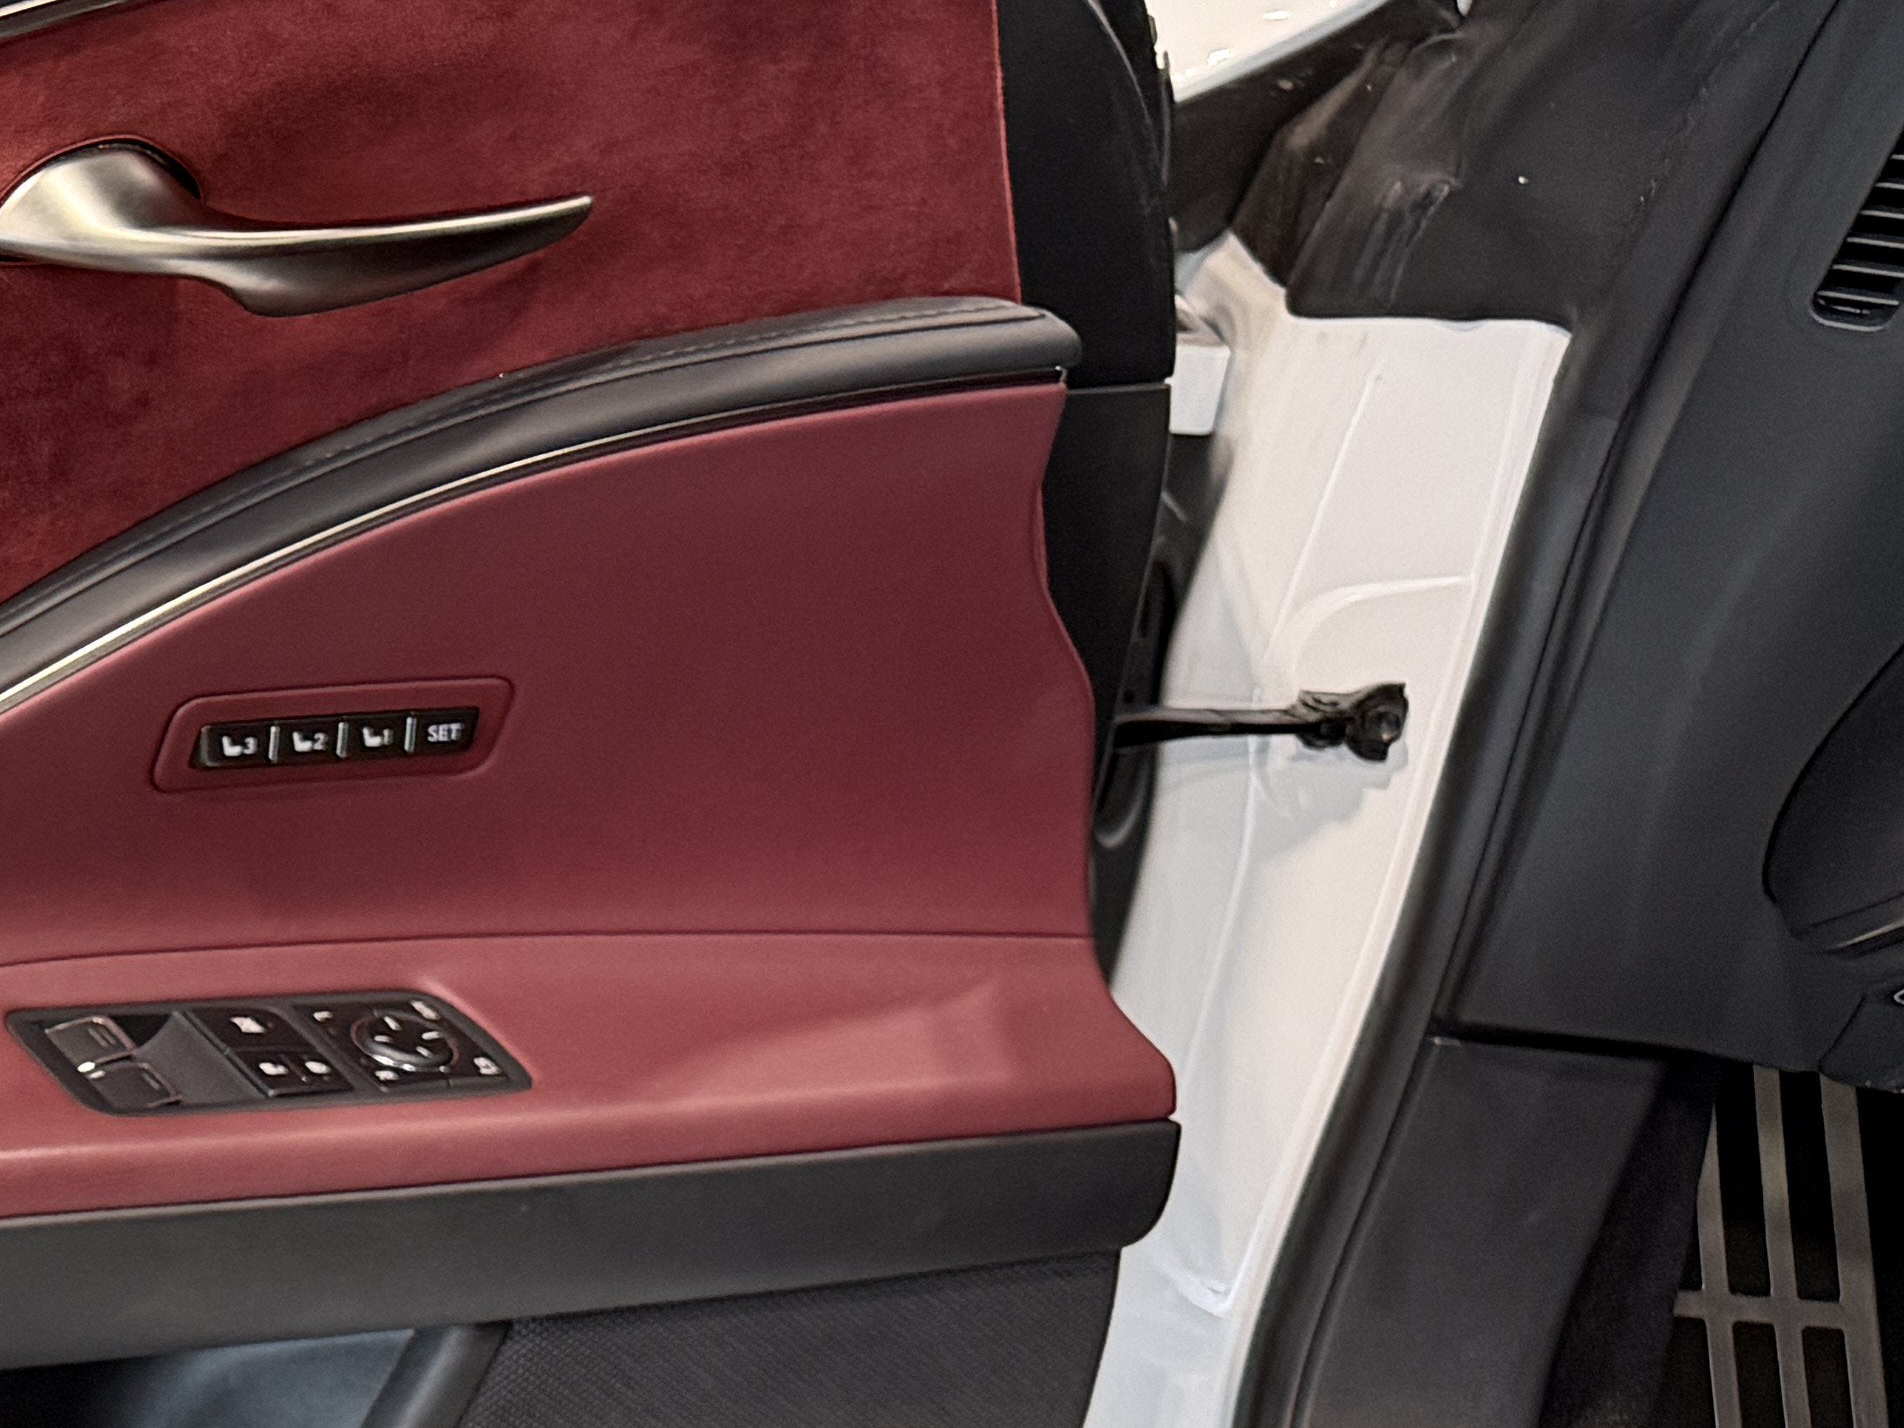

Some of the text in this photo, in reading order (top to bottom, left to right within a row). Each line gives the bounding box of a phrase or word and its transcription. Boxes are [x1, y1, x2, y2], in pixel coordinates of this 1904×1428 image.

[312, 732, 329, 751] 2
[381, 728, 391, 745] 1
[426, 722, 465, 743] SET
[243, 736, 259, 755] 3
